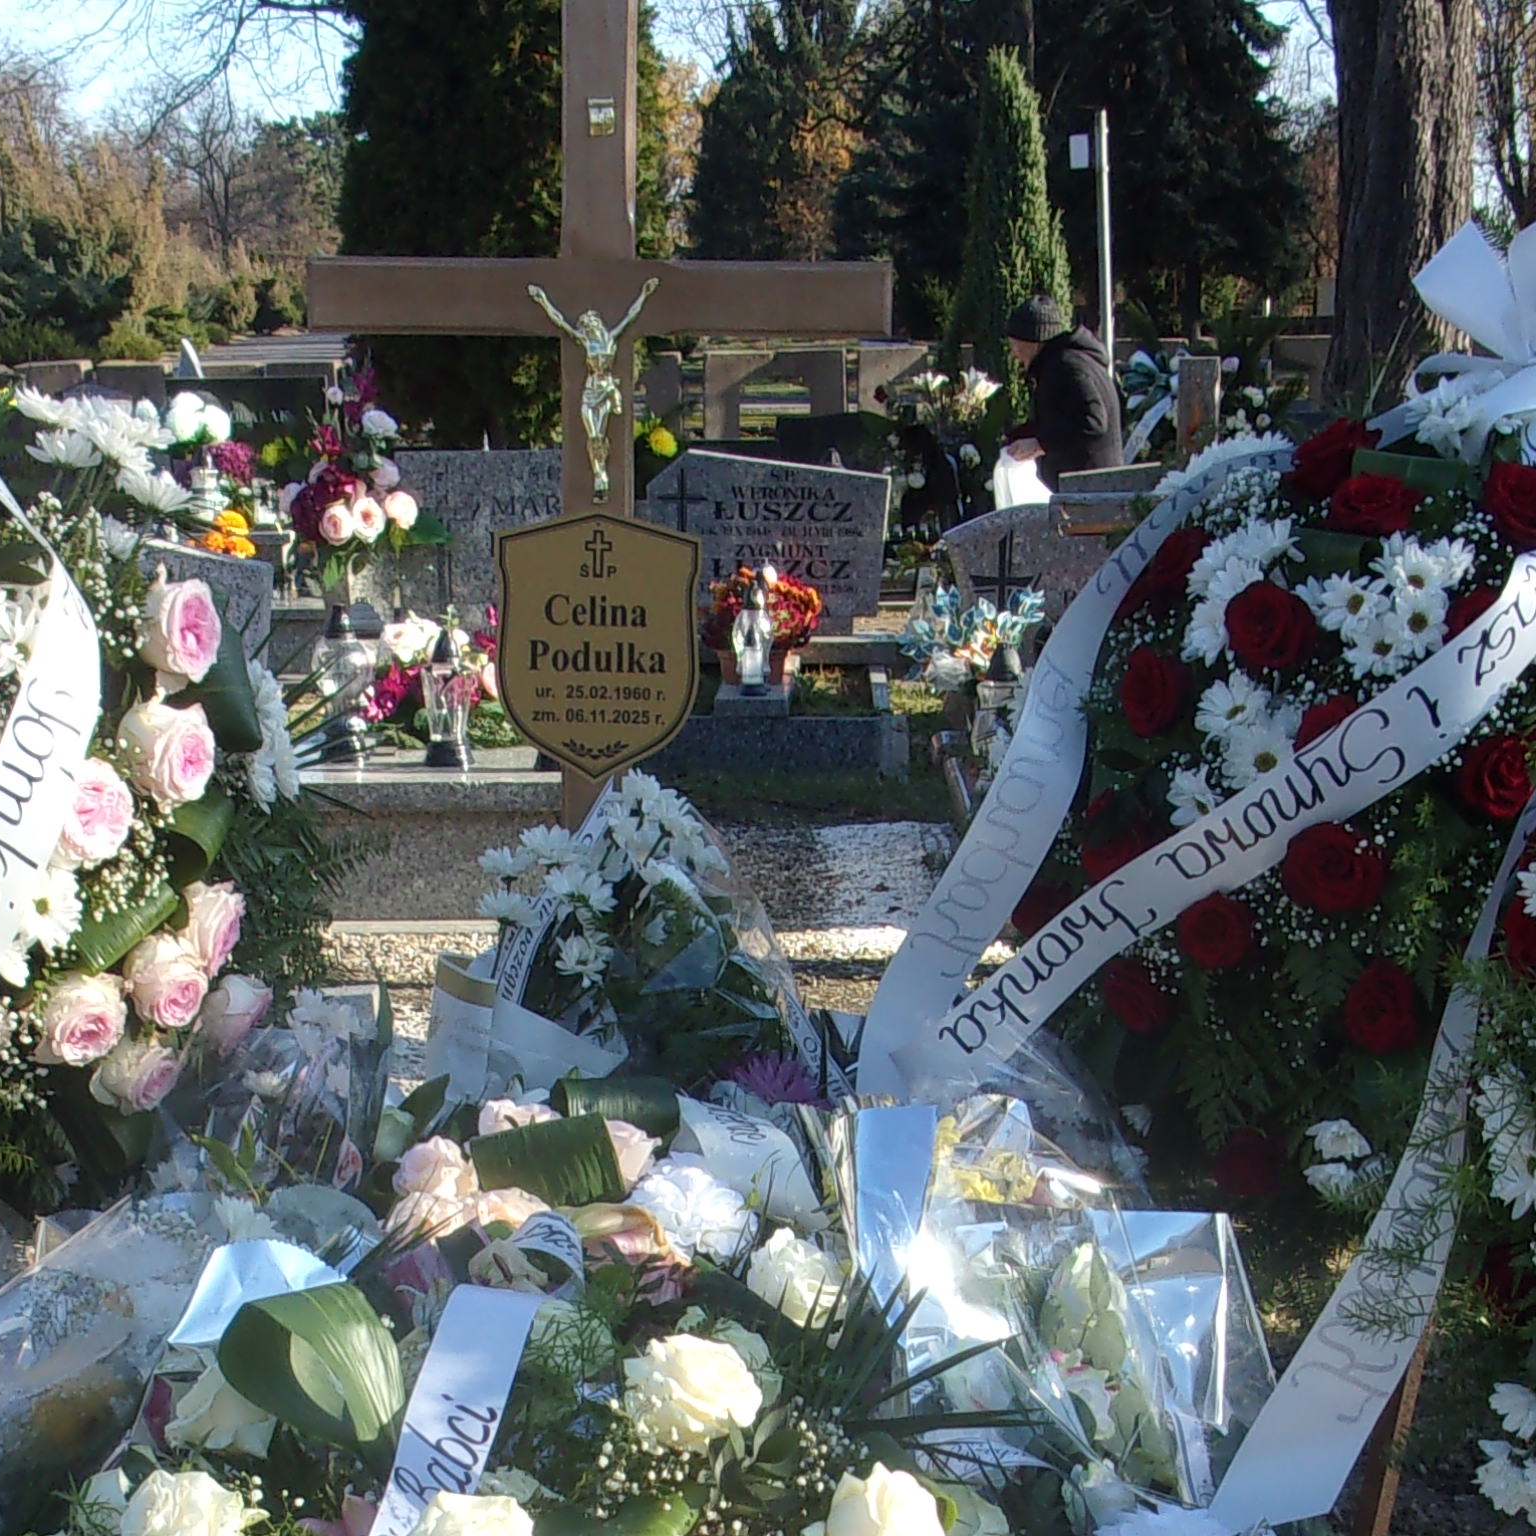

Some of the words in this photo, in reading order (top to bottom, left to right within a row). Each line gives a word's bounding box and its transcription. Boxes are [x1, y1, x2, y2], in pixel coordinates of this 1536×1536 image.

[731, 485, 835, 501] WERONIKA
[714, 501, 854, 523] ŁUSZCZ
[735, 544, 829, 558] ZYGMUNT
[544, 593, 648, 628] Celina
[528, 638, 667, 675] Podulka
[535, 685, 556, 700] ur.
[565, 684, 651, 701] 25.02.1960
[532, 710, 560, 723] zm.
[565, 709, 651, 726] 06.11.2025
[1157, 724, 1411, 886] Synowa
[937, 876, 1161, 1056] Iwonka
[394, 1393, 500, 1505] Babci
